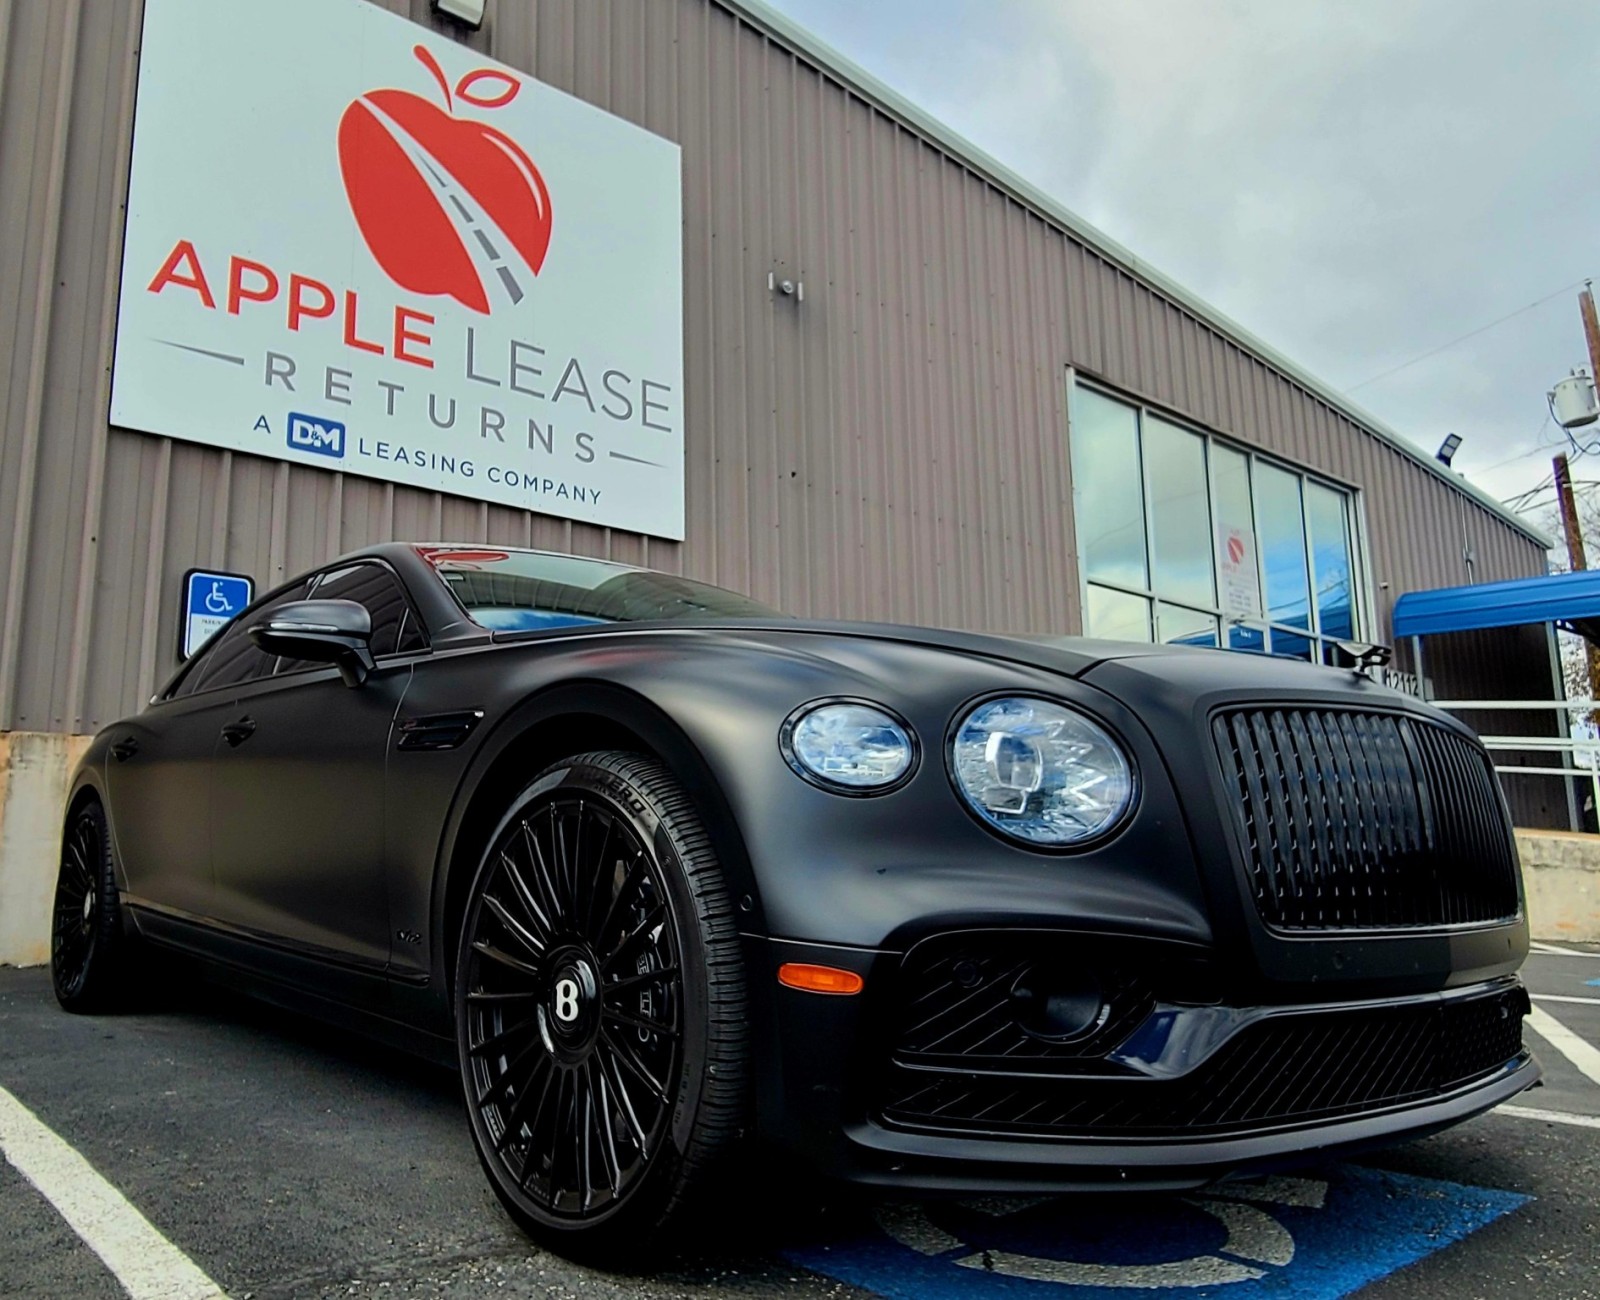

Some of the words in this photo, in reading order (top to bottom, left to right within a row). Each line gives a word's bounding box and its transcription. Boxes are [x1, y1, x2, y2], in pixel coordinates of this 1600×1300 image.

[146, 239, 436, 370] APPLE
[465, 326, 674, 433] LEASE
[253, 414, 272, 435] A
[292, 418, 341, 452] D&M
[358, 437, 476, 478] LEASING
[487, 467, 602, 506] COMPANY
[264, 351, 596, 464] RETURNS
